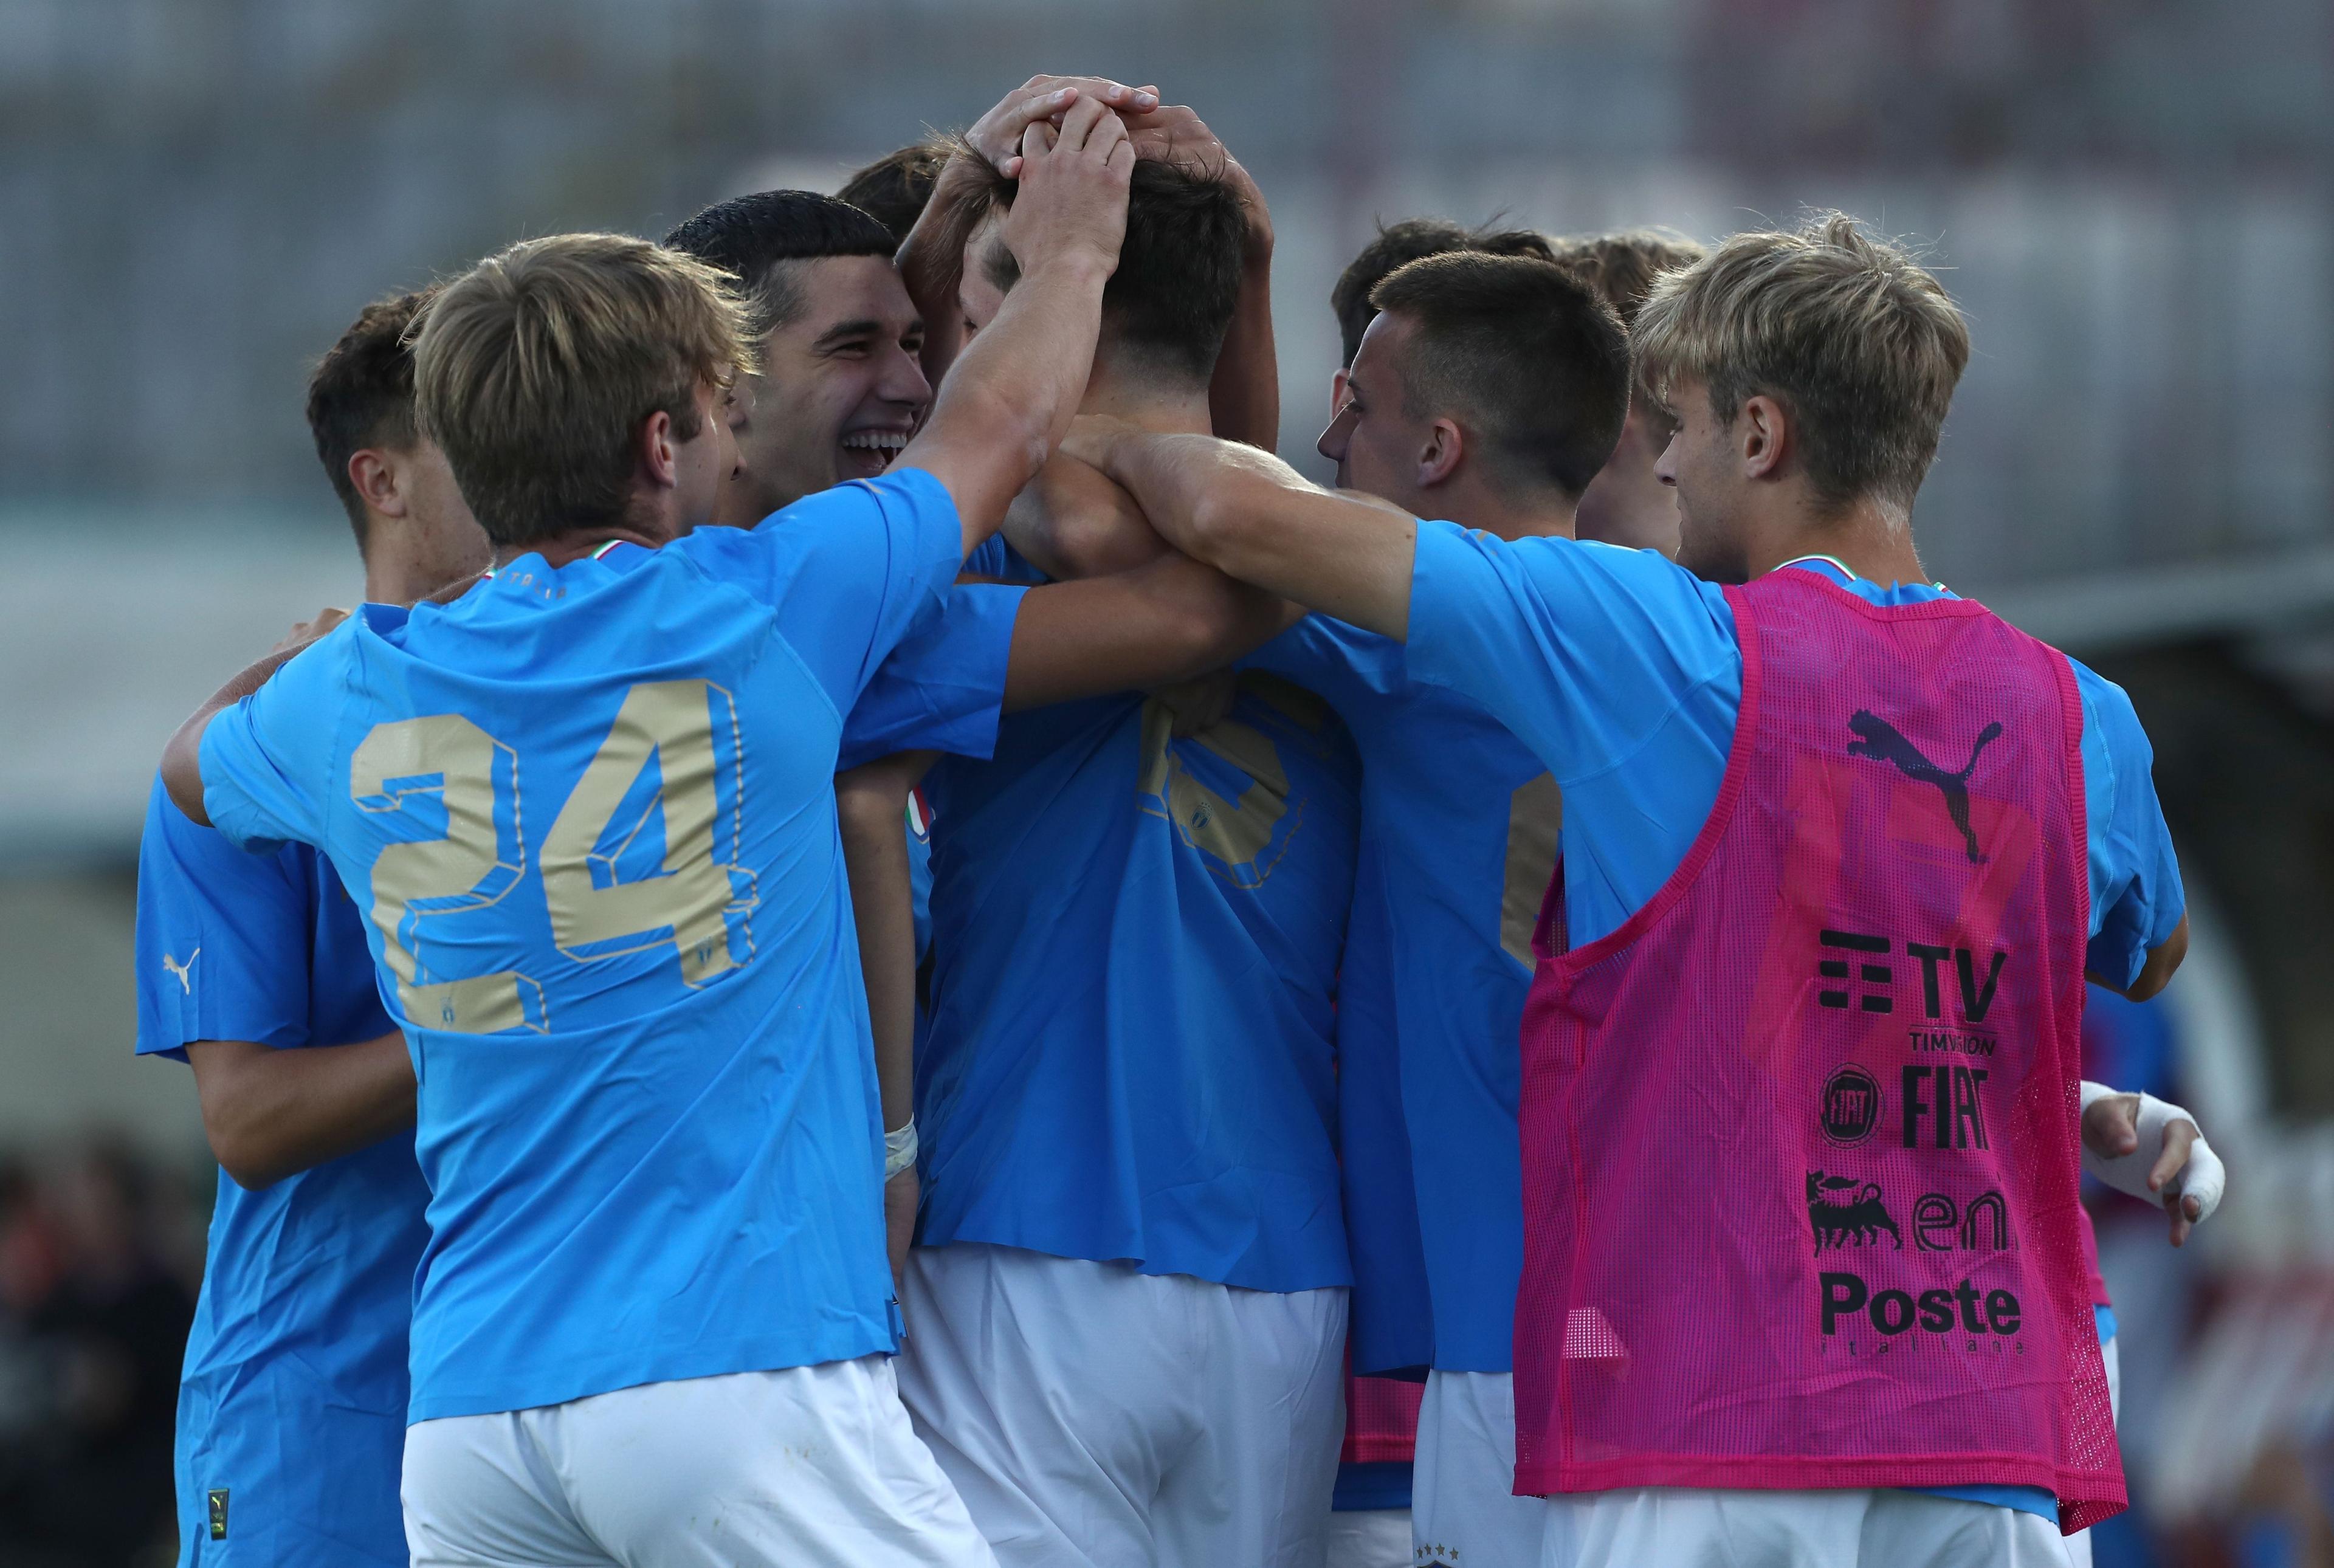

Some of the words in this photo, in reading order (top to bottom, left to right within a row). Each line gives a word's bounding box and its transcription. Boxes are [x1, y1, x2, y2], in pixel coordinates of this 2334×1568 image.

[350, 678, 760, 1036] 24
[1908, 943, 2006, 1022] TV
[1909, 1033, 1995, 1056] TIMVION
[1829, 1090, 1868, 1125] FIAT
[1902, 1065, 1989, 1150] FIAT
[1820, 1271, 2022, 1336] Poste
